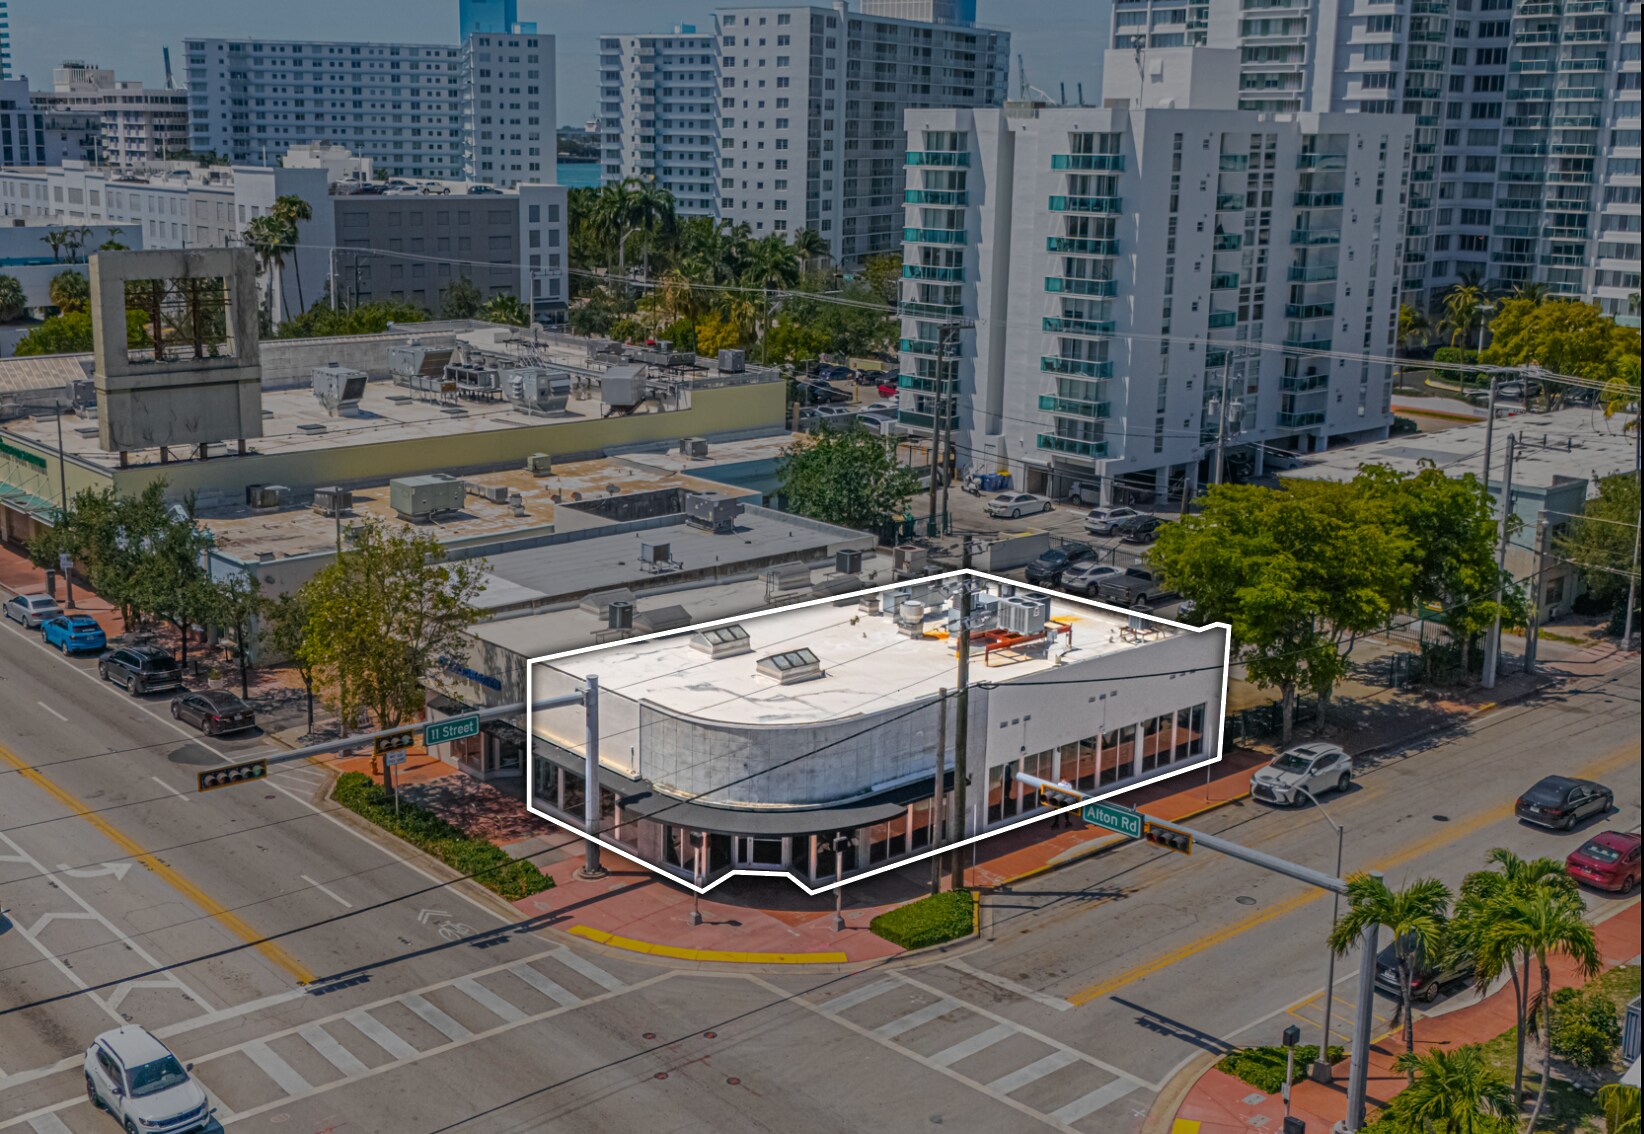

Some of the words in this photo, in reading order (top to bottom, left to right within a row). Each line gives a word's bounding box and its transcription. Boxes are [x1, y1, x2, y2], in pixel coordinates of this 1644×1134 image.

[431, 728, 439, 740] 11
[442, 721, 474, 737] Street
[1087, 806, 1118, 826] Alton
[1121, 816, 1137, 833] Rd
